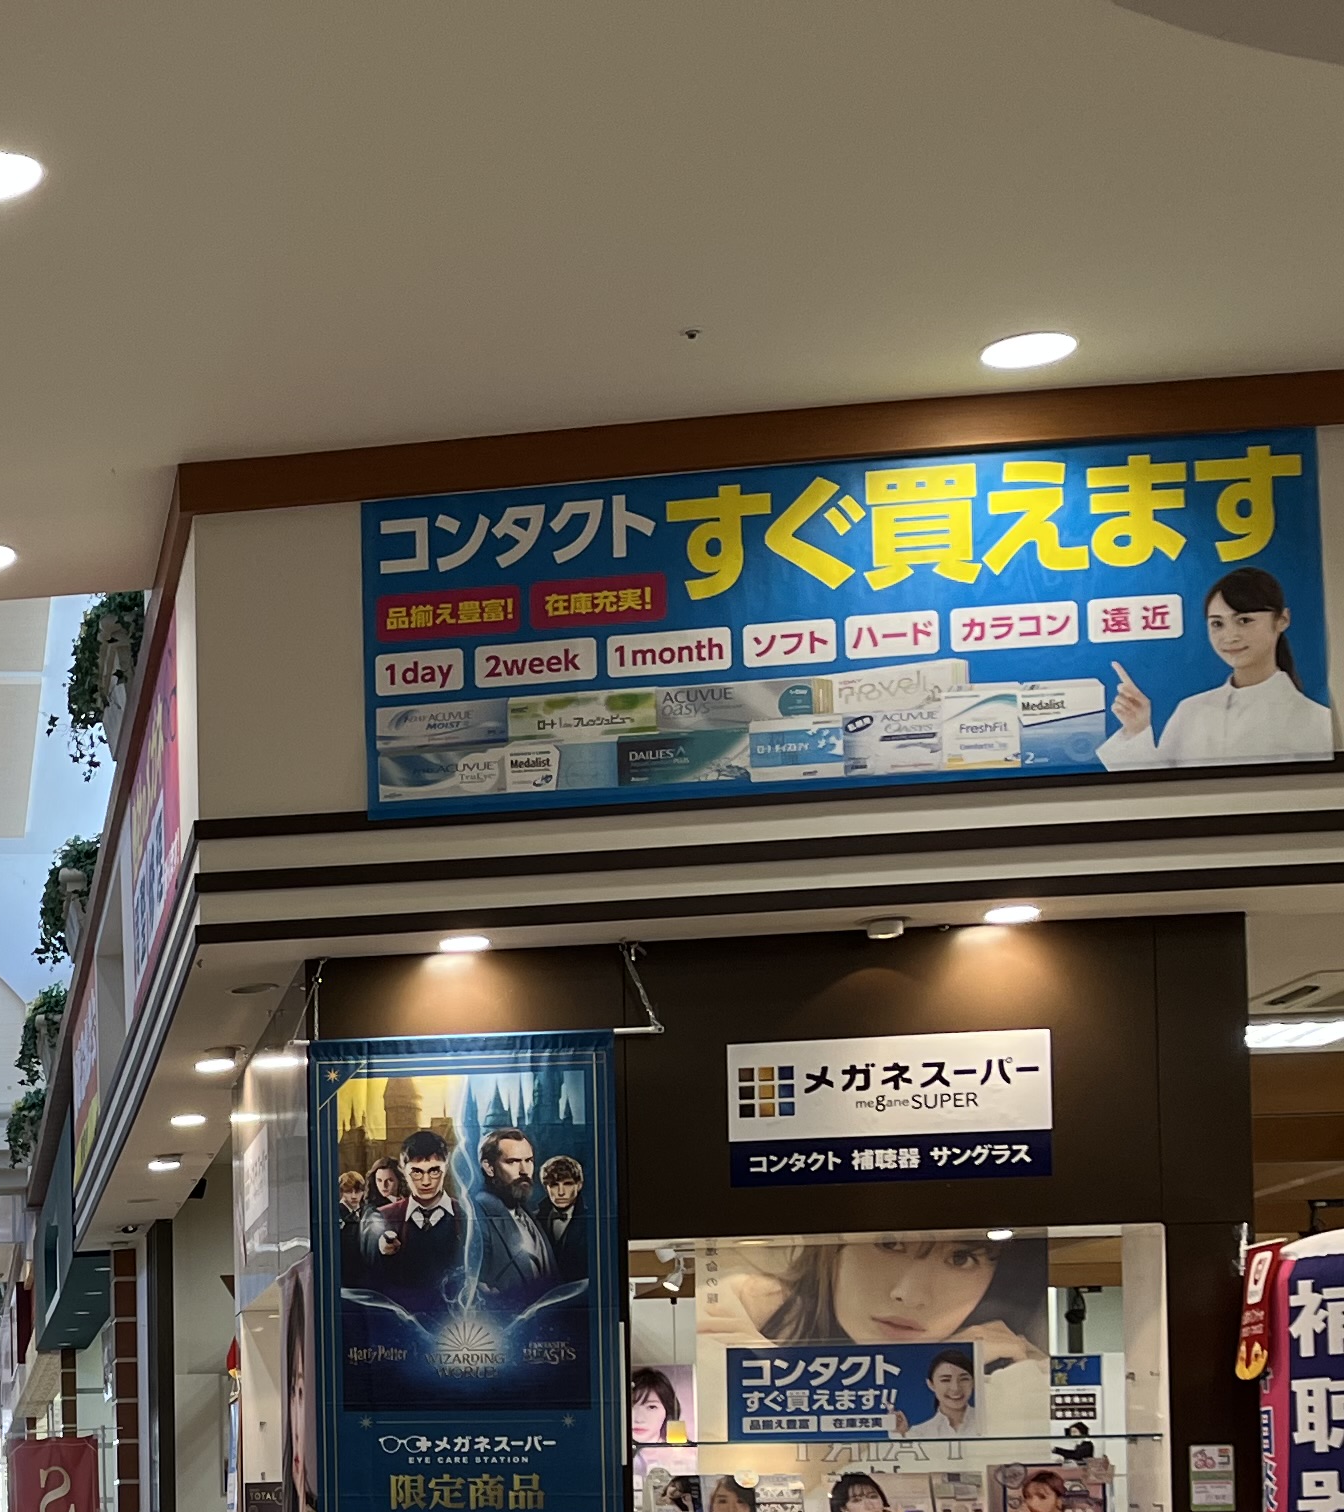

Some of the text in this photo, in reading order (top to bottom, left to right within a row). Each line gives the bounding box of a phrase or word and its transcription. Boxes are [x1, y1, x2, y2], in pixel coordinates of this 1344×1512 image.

[379, 444, 1304, 601] コンタクト すぐ買えます
[385, 597, 515, 632] 品揃え豊富!
[544, 585, 653, 618] 在庫充実!
[852, 620, 934, 651] ハード
[961, 613, 1073, 642] カラコン
[614, 636, 725, 668] 1month
[753, 629, 829, 659] ソフト
[385, 660, 454, 688] 1day
[483, 647, 581, 679] 2week
[662, 686, 735, 704] ACUVUE
[1021, 699, 1066, 711] Medalist
[429, 710, 473, 723] ACUVUE
[881, 711, 938, 722] ACUVUE
[959, 721, 1009, 734] FreshFit
[510, 757, 552, 769] Medalist
[628, 748, 675, 762] DAILIES
[803, 1056, 1040, 1094] メガネスーパー
[749, 1144, 1033, 1173] コンタクト 補聴器 サングラス
[425, 1352, 506, 1365] WIZARDING
[741, 1354, 901, 1387] コンタクト
[742, 1387, 898, 1414] すぐ買えます!!
[749, 1417, 811, 1432] 品揃え豊富
[832, 1416, 883, 1429] 在庫充実
[434, 1435, 557, 1453] メガネスーパー
[408, 1455, 530, 1464] EYE CARE STATION
[389, 1473, 546, 1511] 限定商品
